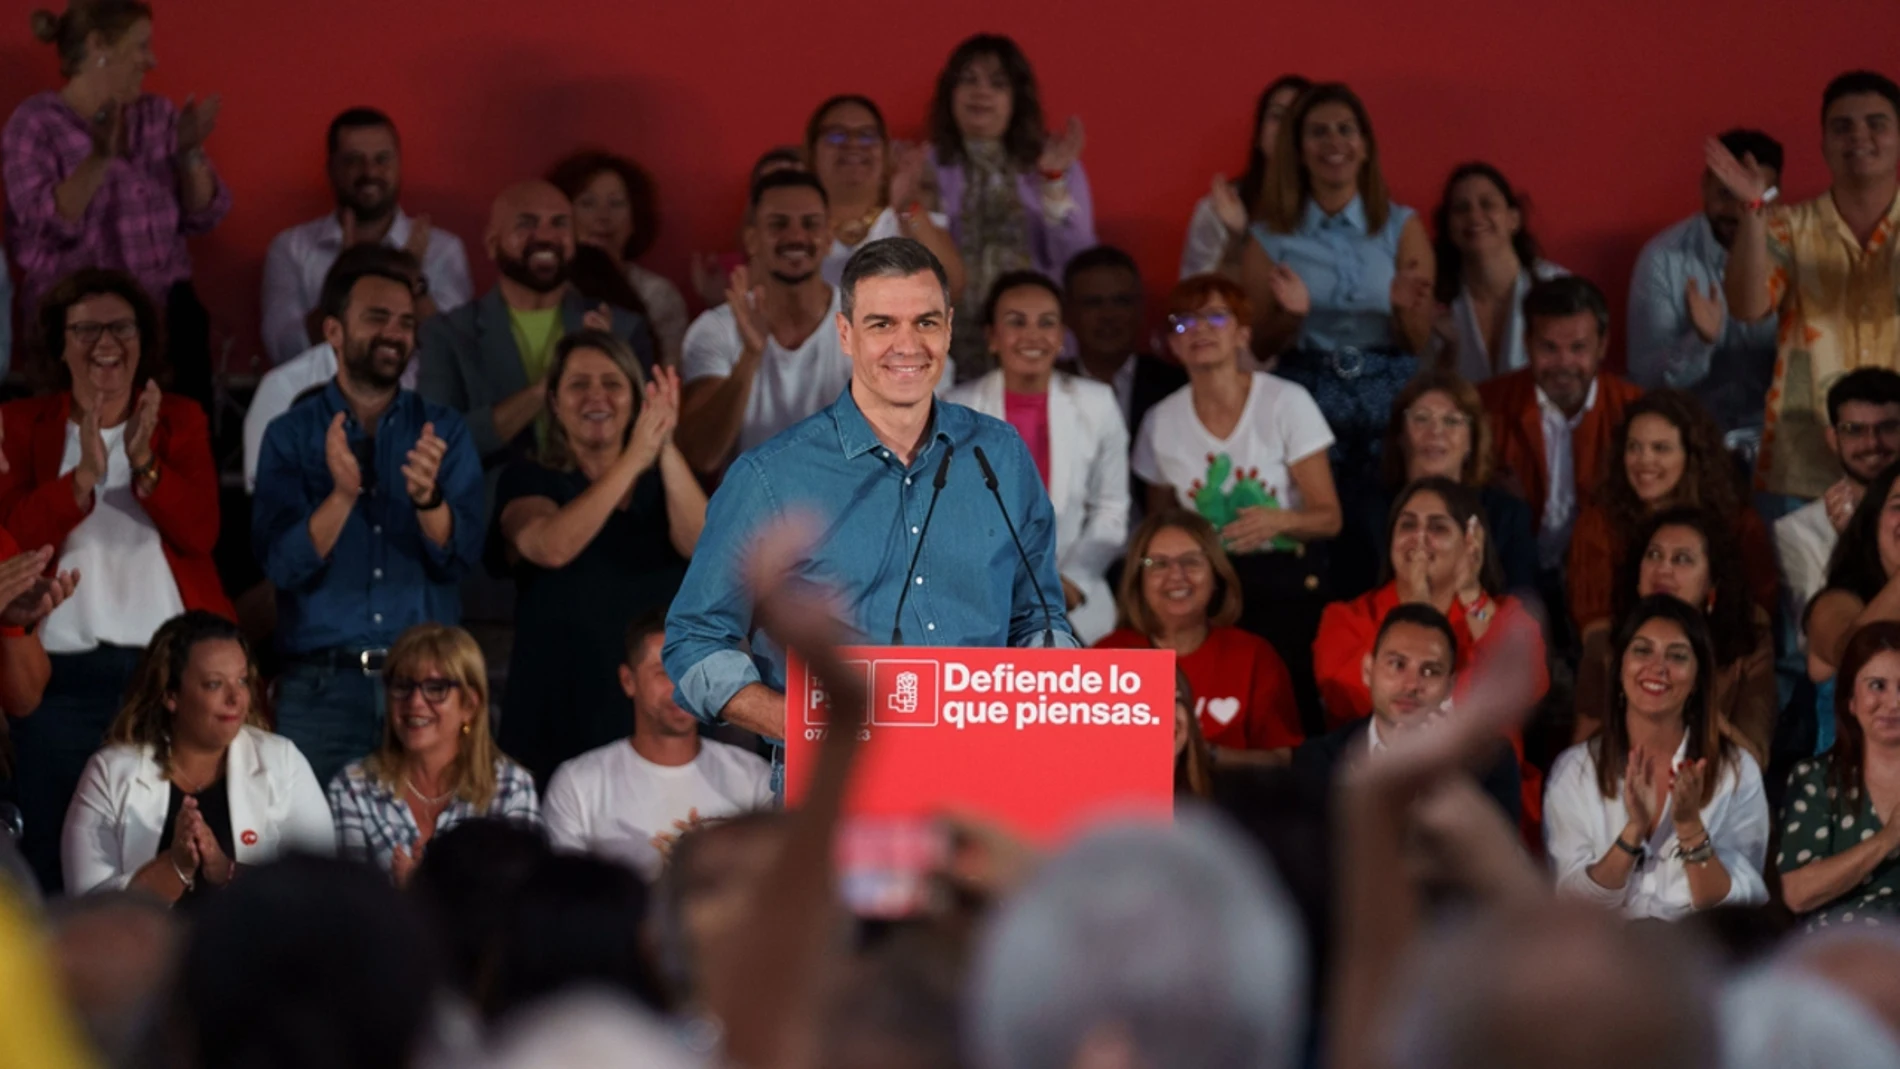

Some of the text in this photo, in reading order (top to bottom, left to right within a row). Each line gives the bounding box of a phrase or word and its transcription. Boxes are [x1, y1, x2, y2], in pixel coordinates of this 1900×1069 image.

[944, 662, 1142, 694] Defiende lo
[942, 700, 1009, 729] que
[1015, 694, 1160, 730] piensas.
